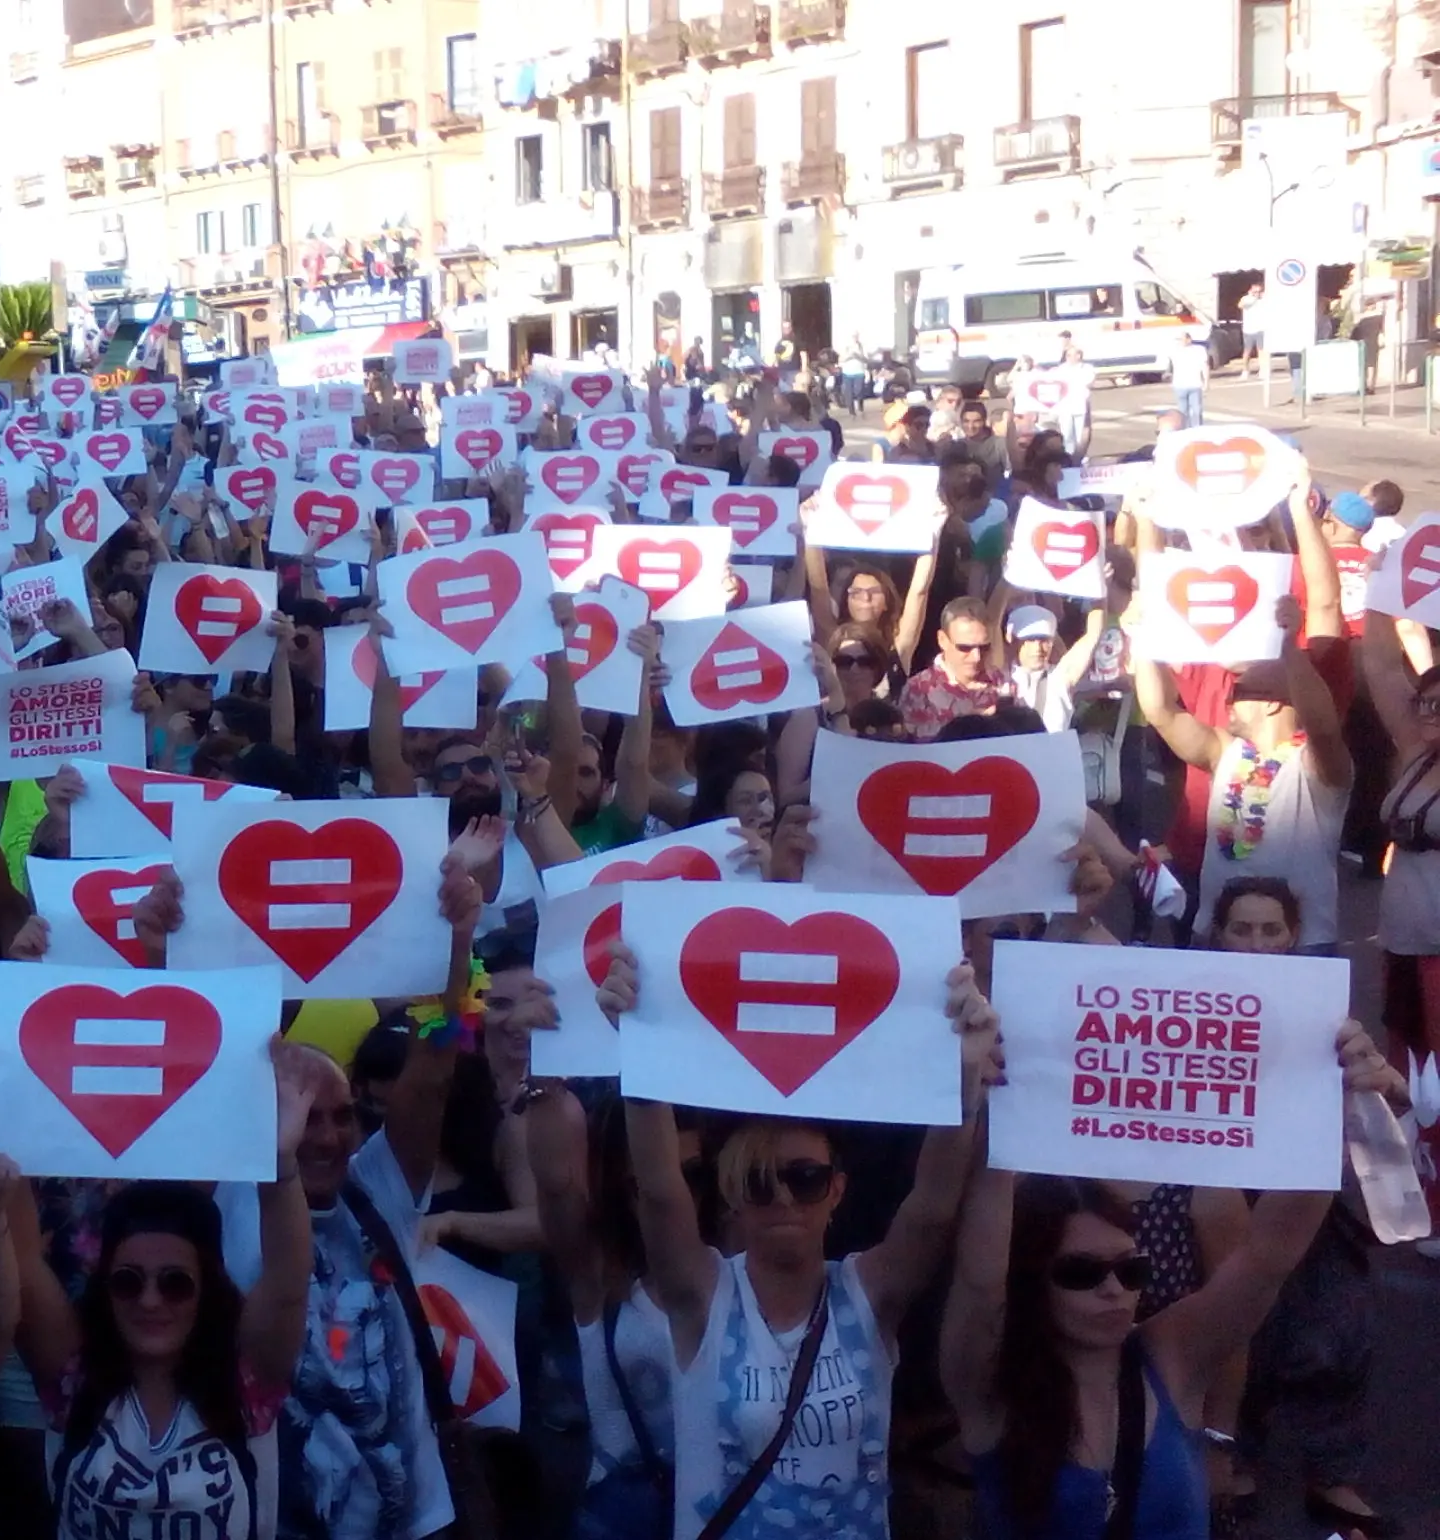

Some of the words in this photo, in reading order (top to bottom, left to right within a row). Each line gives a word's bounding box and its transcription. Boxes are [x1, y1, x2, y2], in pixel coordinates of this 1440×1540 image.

[6, 584, 56, 611] MORE
[10, 687, 32, 700] LO
[38, 677, 103, 695] STESSO
[10, 690, 103, 713] AMORE
[10, 711, 37, 726] GLI
[43, 704, 101, 723] STESSI
[9, 718, 103, 743] DIRITTI
[1076, 984, 1120, 1009] LO
[1131, 987, 1262, 1018] STESSO
[1075, 1011, 1261, 1053] AMORE
[1074, 1047, 1130, 1074] GLI
[1141, 1051, 1258, 1082] STESSI
[1071, 1074, 1256, 1117] DIRITTI
[67, 1488, 236, 1540] ENJOY
